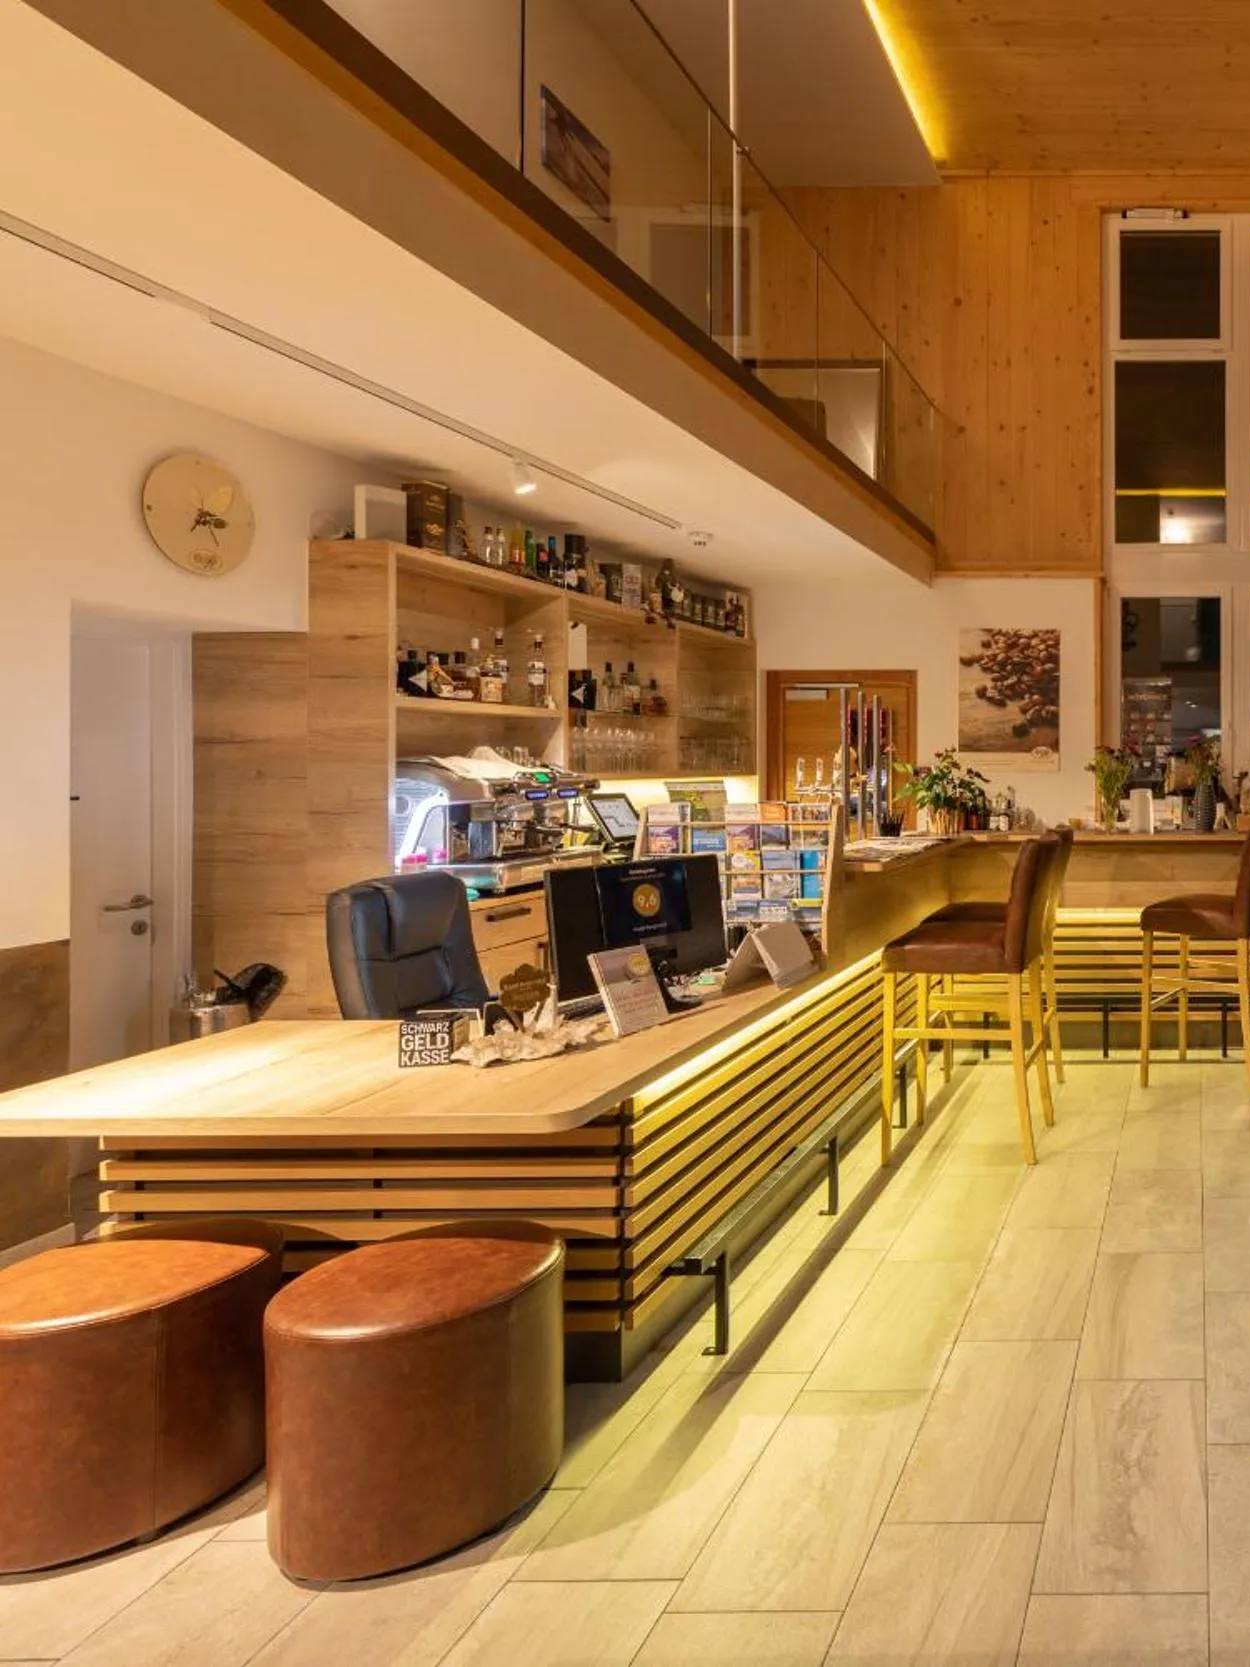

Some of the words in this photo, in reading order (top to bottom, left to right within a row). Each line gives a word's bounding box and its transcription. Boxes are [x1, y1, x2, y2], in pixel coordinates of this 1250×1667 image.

[401, 1022, 449, 1034] SCHWARZ
[401, 1033, 450, 1051] GELD
[401, 1050, 449, 1066] KASSE
